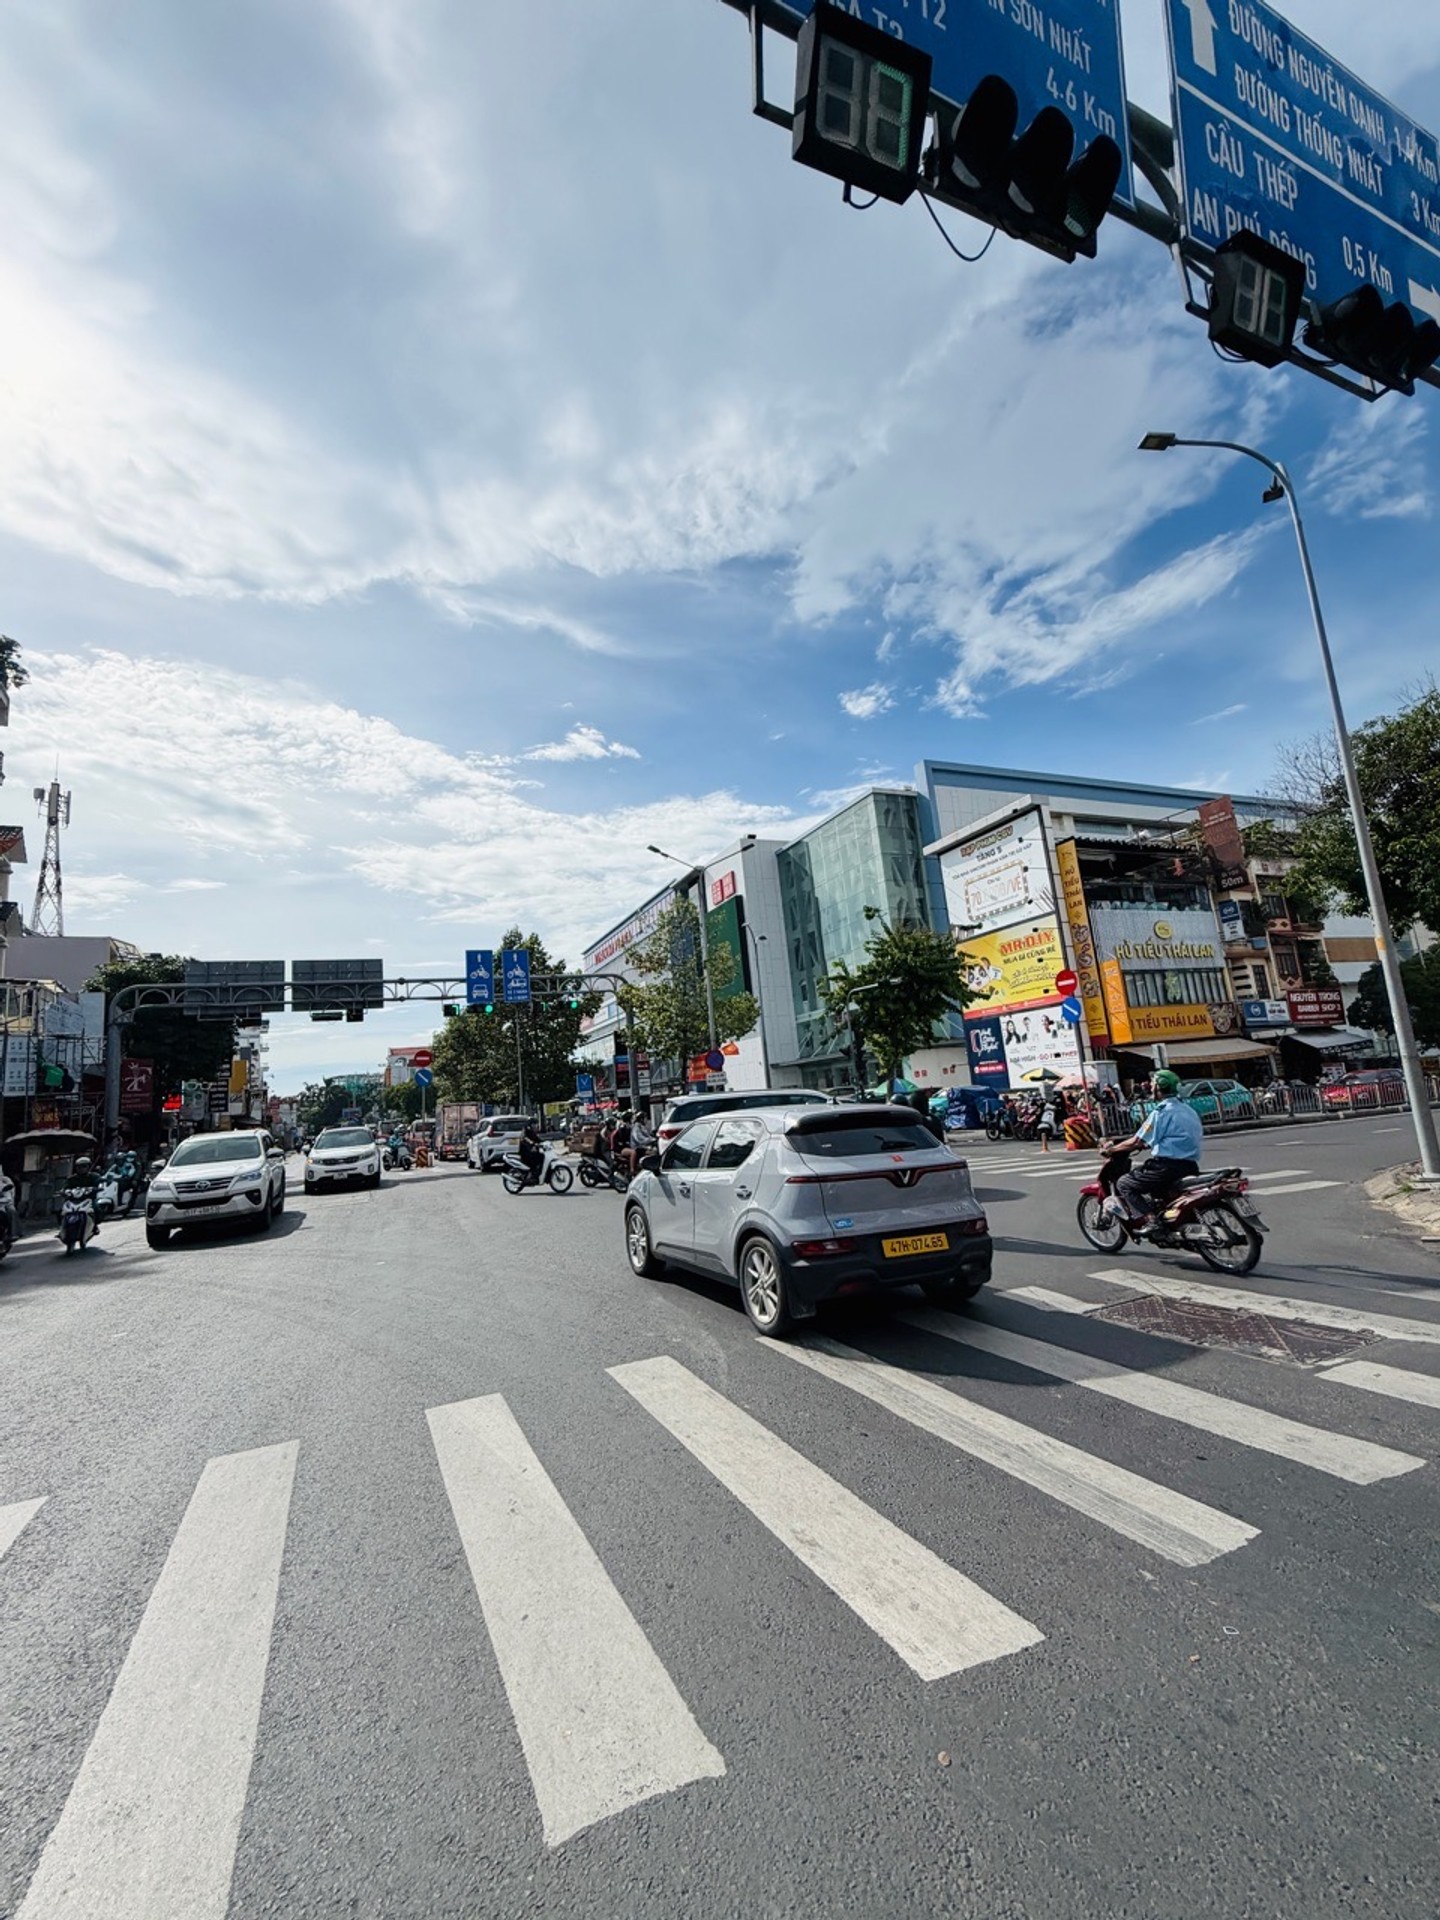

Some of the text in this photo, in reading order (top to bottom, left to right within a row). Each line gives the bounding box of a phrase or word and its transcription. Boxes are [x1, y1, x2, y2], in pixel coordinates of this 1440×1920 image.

[1048, 17, 1093, 74] NHẤT
[1083, 89, 1117, 140] Km
[1287, 44, 1348, 117] NGUYỄN
[1349, 91, 1386, 147] OANH
[1204, 118, 1299, 212] CẦU THÉP
[1234, 62, 1291, 133] ĐƯỜNG
[1292, 104, 1344, 170] THỐNG
[1346, 145, 1384, 197] NHẤT
[1410, 190, 1421, 223] 3
[1192, 186, 1221, 239] AN
[1367, 249, 1394, 295] Km
[1191, 943, 1215, 959] LAN
[1135, 1012, 1209, 1030] TIẾU THÁI LAN
[890, 1234, 944, 1253] 47H-074.65
